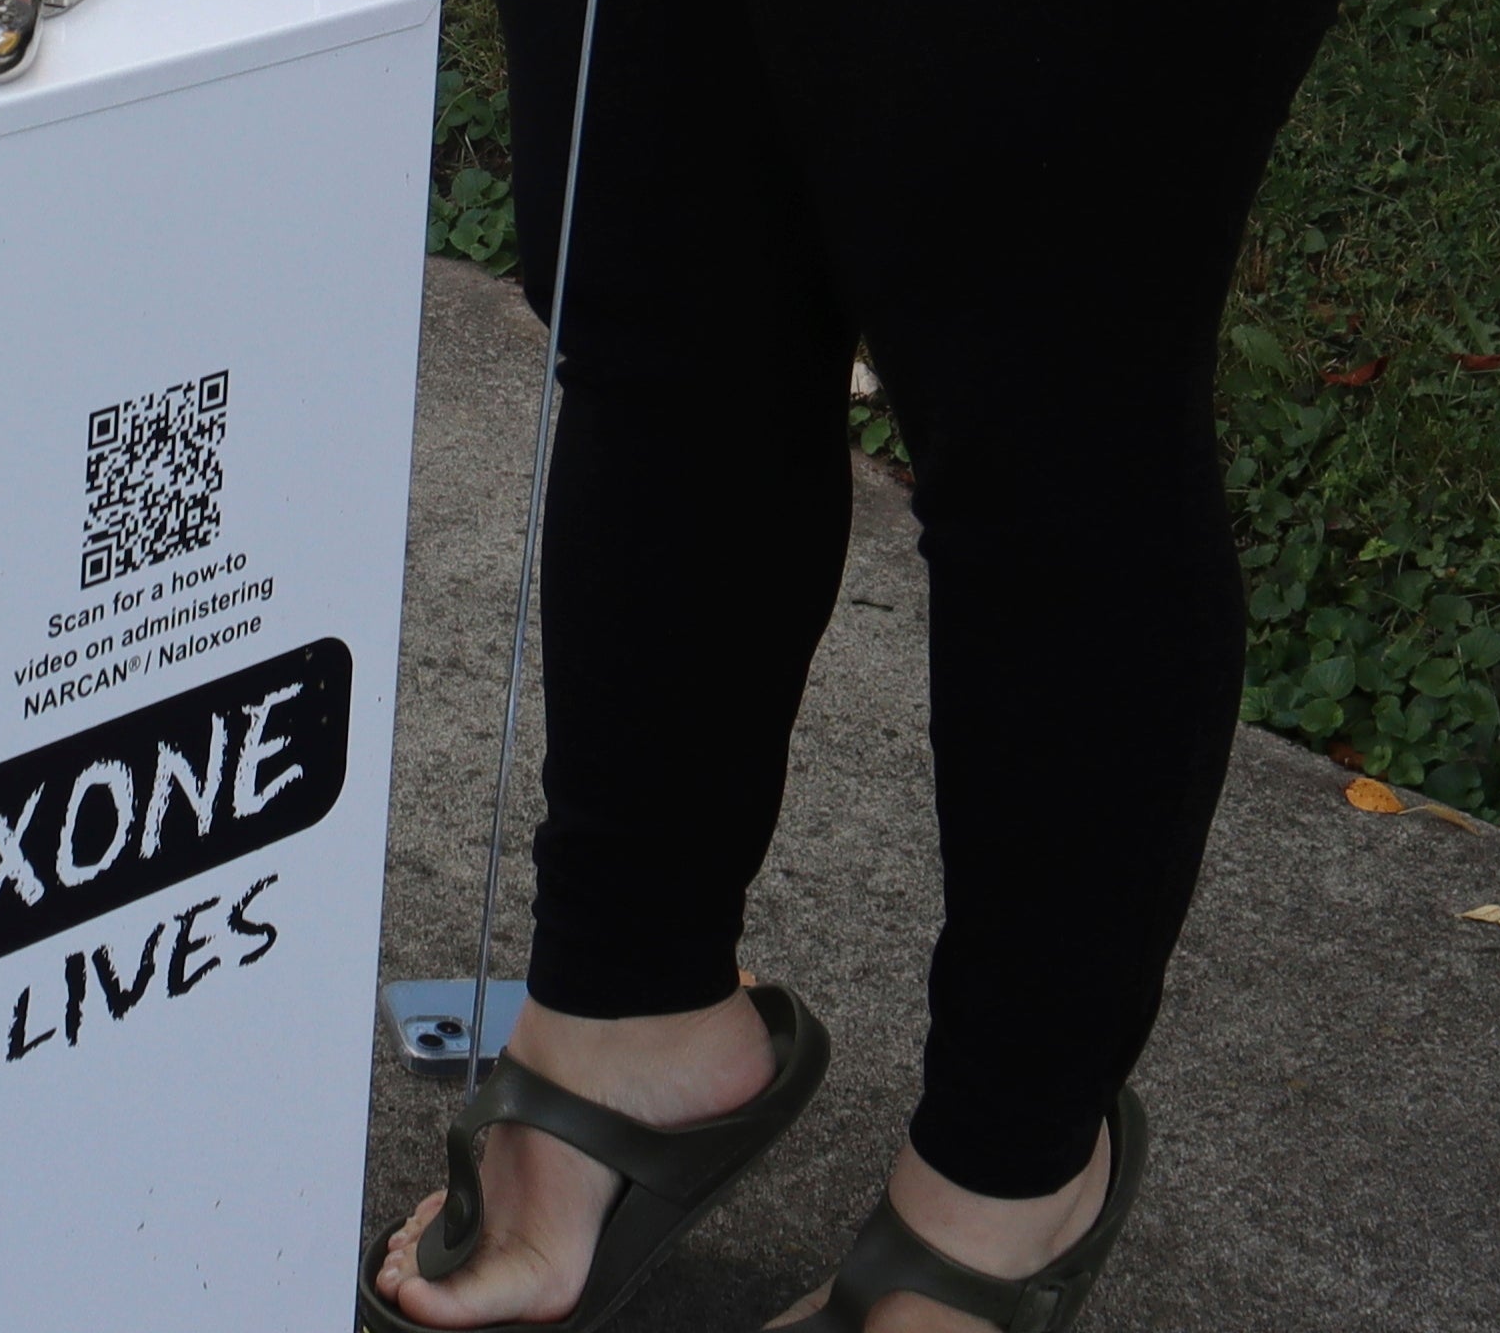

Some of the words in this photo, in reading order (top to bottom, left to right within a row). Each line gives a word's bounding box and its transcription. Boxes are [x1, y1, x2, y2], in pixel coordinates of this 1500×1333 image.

[14, 649, 77, 685] video
[85, 636, 113, 659] on
[121, 576, 274, 646] administering
[48, 604, 104, 638] Scan
[114, 587, 144, 616] for
[151, 583, 163, 601] a
[172, 552, 247, 594] how-to
[159, 616, 261, 669] Naloxone
[5, 873, 279, 1062] LIVES
